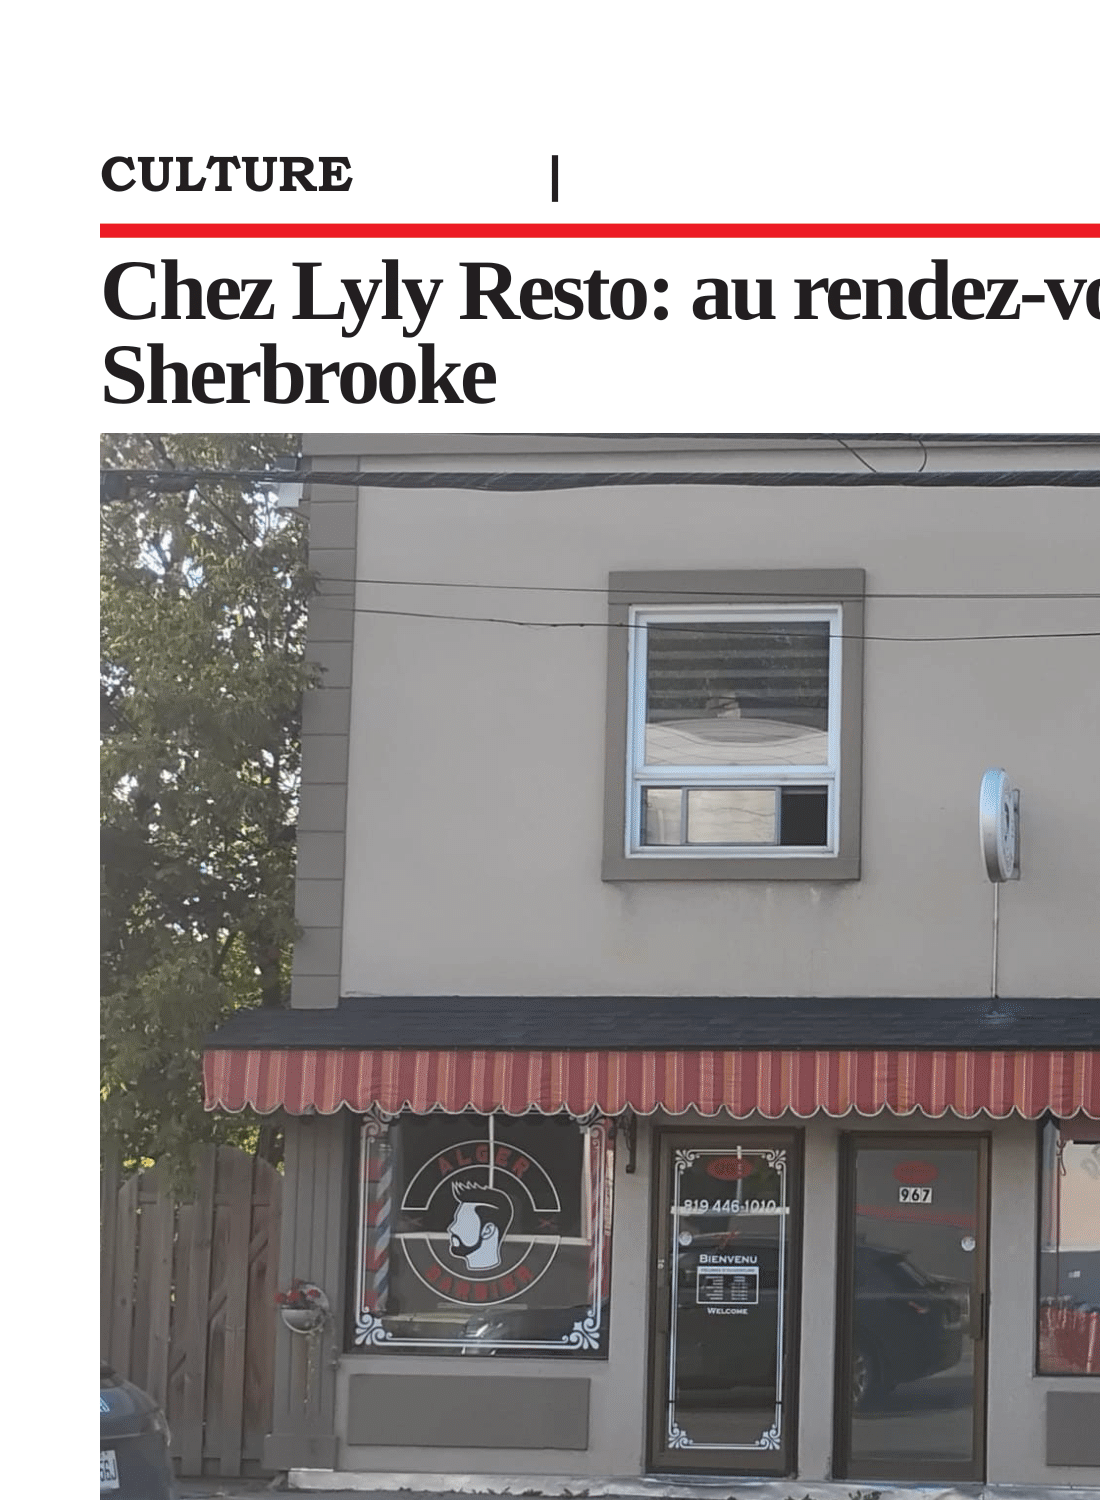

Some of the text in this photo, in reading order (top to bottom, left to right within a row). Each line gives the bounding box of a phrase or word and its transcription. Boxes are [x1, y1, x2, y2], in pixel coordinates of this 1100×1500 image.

[102, 156, 353, 192] CULTURE
[104, 259, 274, 320] Chez
[293, 259, 443, 338] Lyly
[460, 263, 668, 320] Resto:
[693, 279, 776, 320] au
[105, 343, 496, 404] Sherbrooke
[684, 1199, 709, 1213] 819
[901, 1188, 930, 1202] 967
